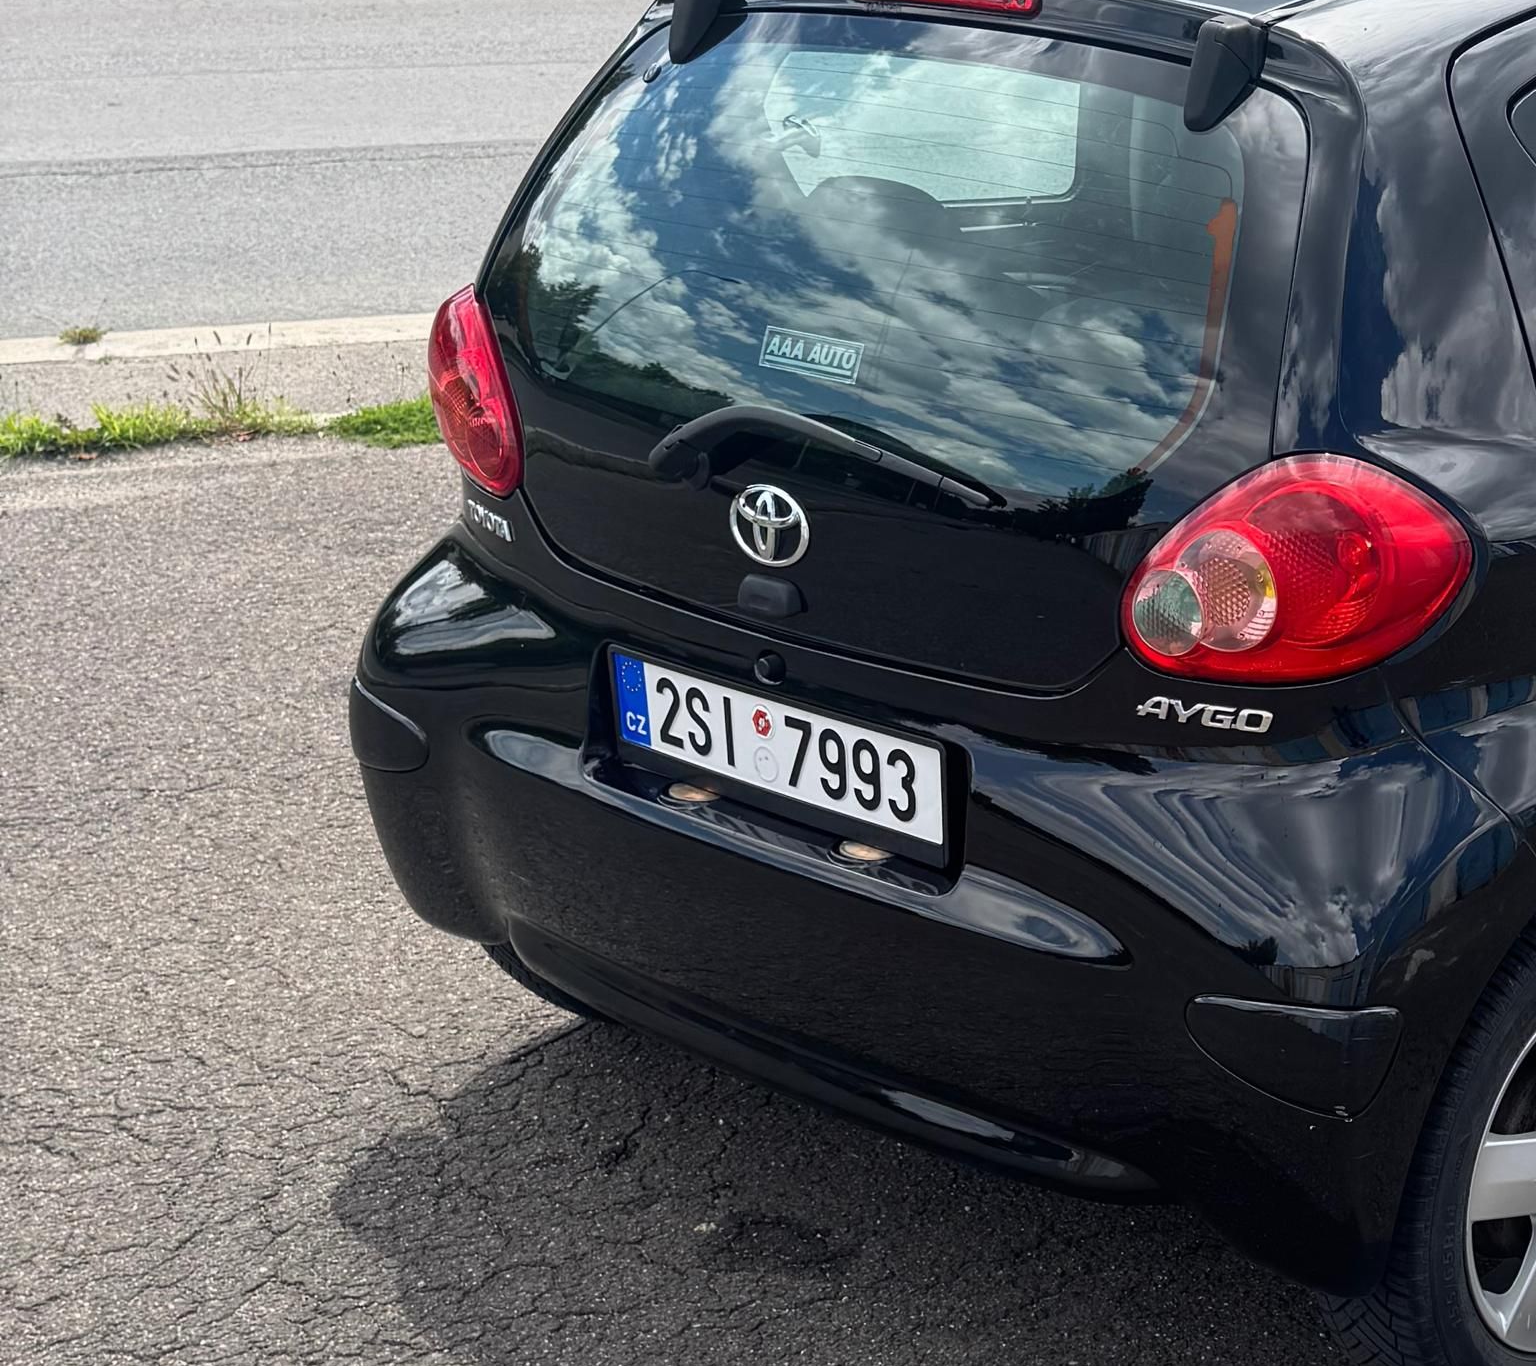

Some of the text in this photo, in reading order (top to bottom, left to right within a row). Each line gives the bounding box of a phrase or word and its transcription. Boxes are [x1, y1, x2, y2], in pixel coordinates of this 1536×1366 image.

[767, 336, 856, 369] AAA AUTO
[467, 499, 515, 542] TOYOTA
[626, 711, 647, 735] CZ
[1136, 696, 1274, 733] AYGO
[656, 677, 917, 822] 2SI 7993
